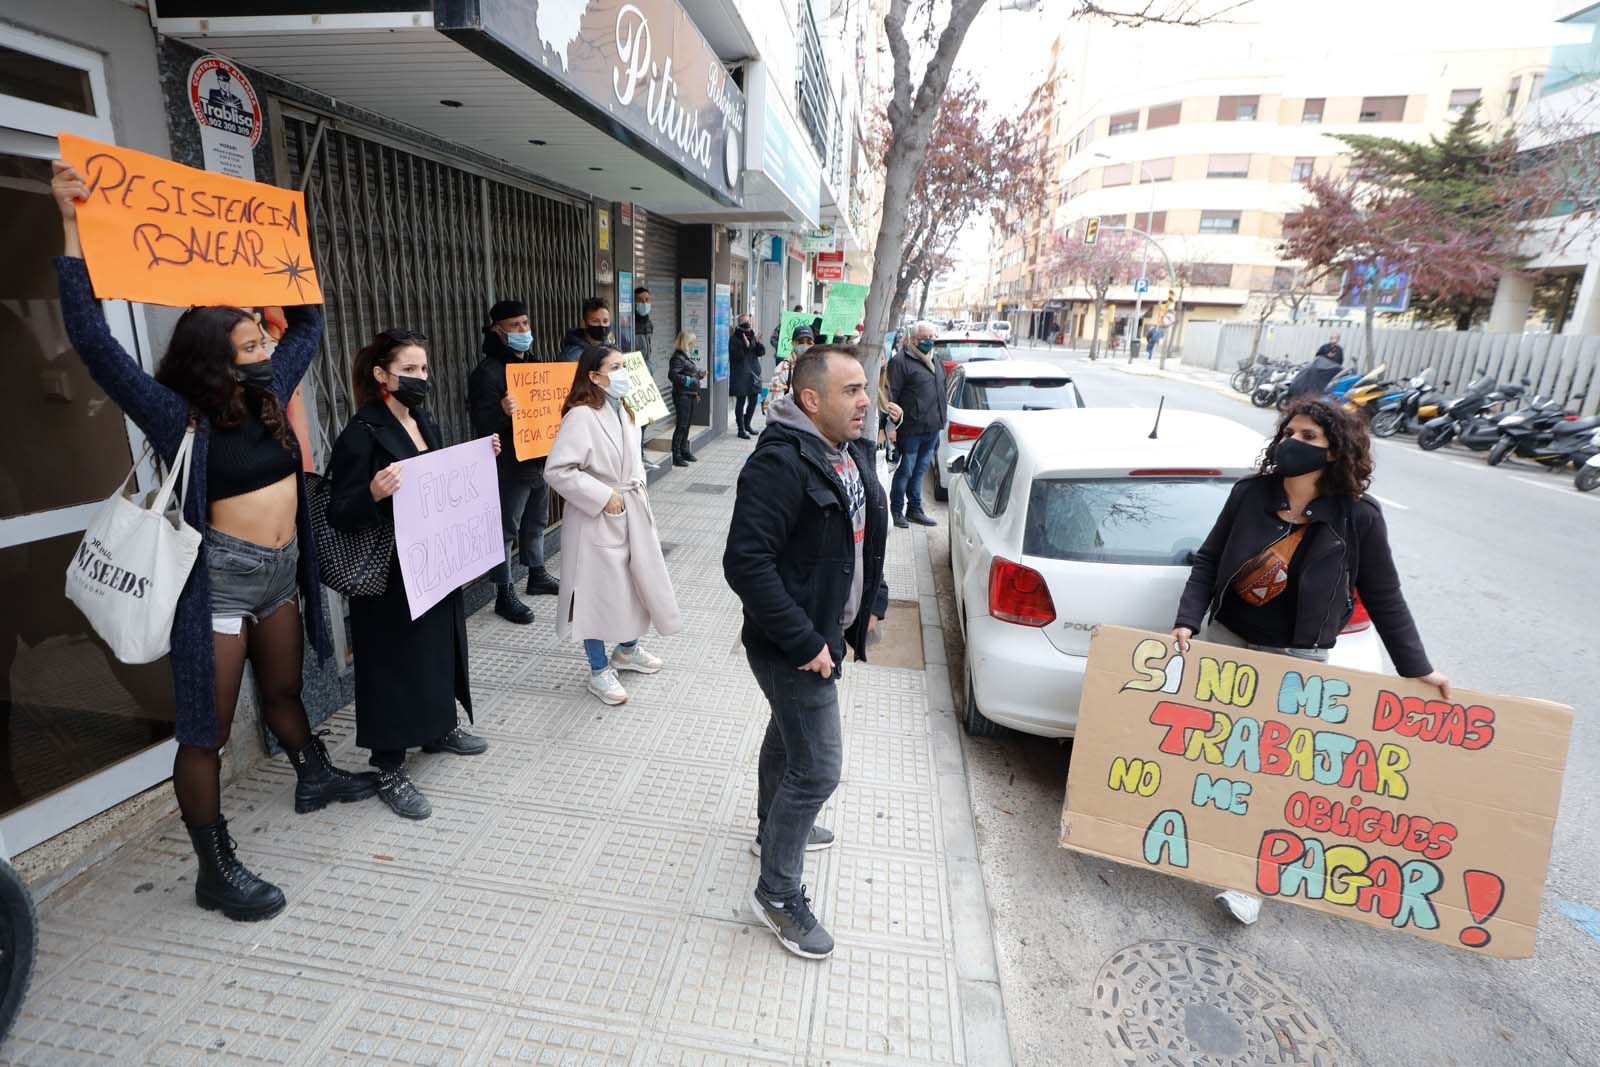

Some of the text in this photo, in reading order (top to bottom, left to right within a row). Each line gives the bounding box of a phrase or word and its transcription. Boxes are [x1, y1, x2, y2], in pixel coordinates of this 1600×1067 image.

[193, 60, 219, 86] CENTRAL
[613, 4, 712, 169] Pitiusa
[199, 98, 253, 128] Trablisa
[85, 153, 301, 237] RESISTENCIA
[133, 222, 277, 271] BALEAR
[512, 370, 550, 387] VICENT
[516, 407, 551, 420] ESCOLTA
[517, 429, 542, 444] TEVA
[417, 462, 480, 519] FUCK
[88, 559, 149, 599] SEEDS
[1063, 621, 1098, 632] POL
[1195, 657, 1259, 707] NO
[1277, 671, 1351, 723] ME
[1372, 690, 1495, 750] DEJAS
[1149, 701, 1411, 800] TRABAJAR
[1108, 756, 1162, 797] NO
[1191, 773, 1252, 816] ME
[1142, 809, 1189, 869] A
[1255, 829, 1445, 930] PAGAR
